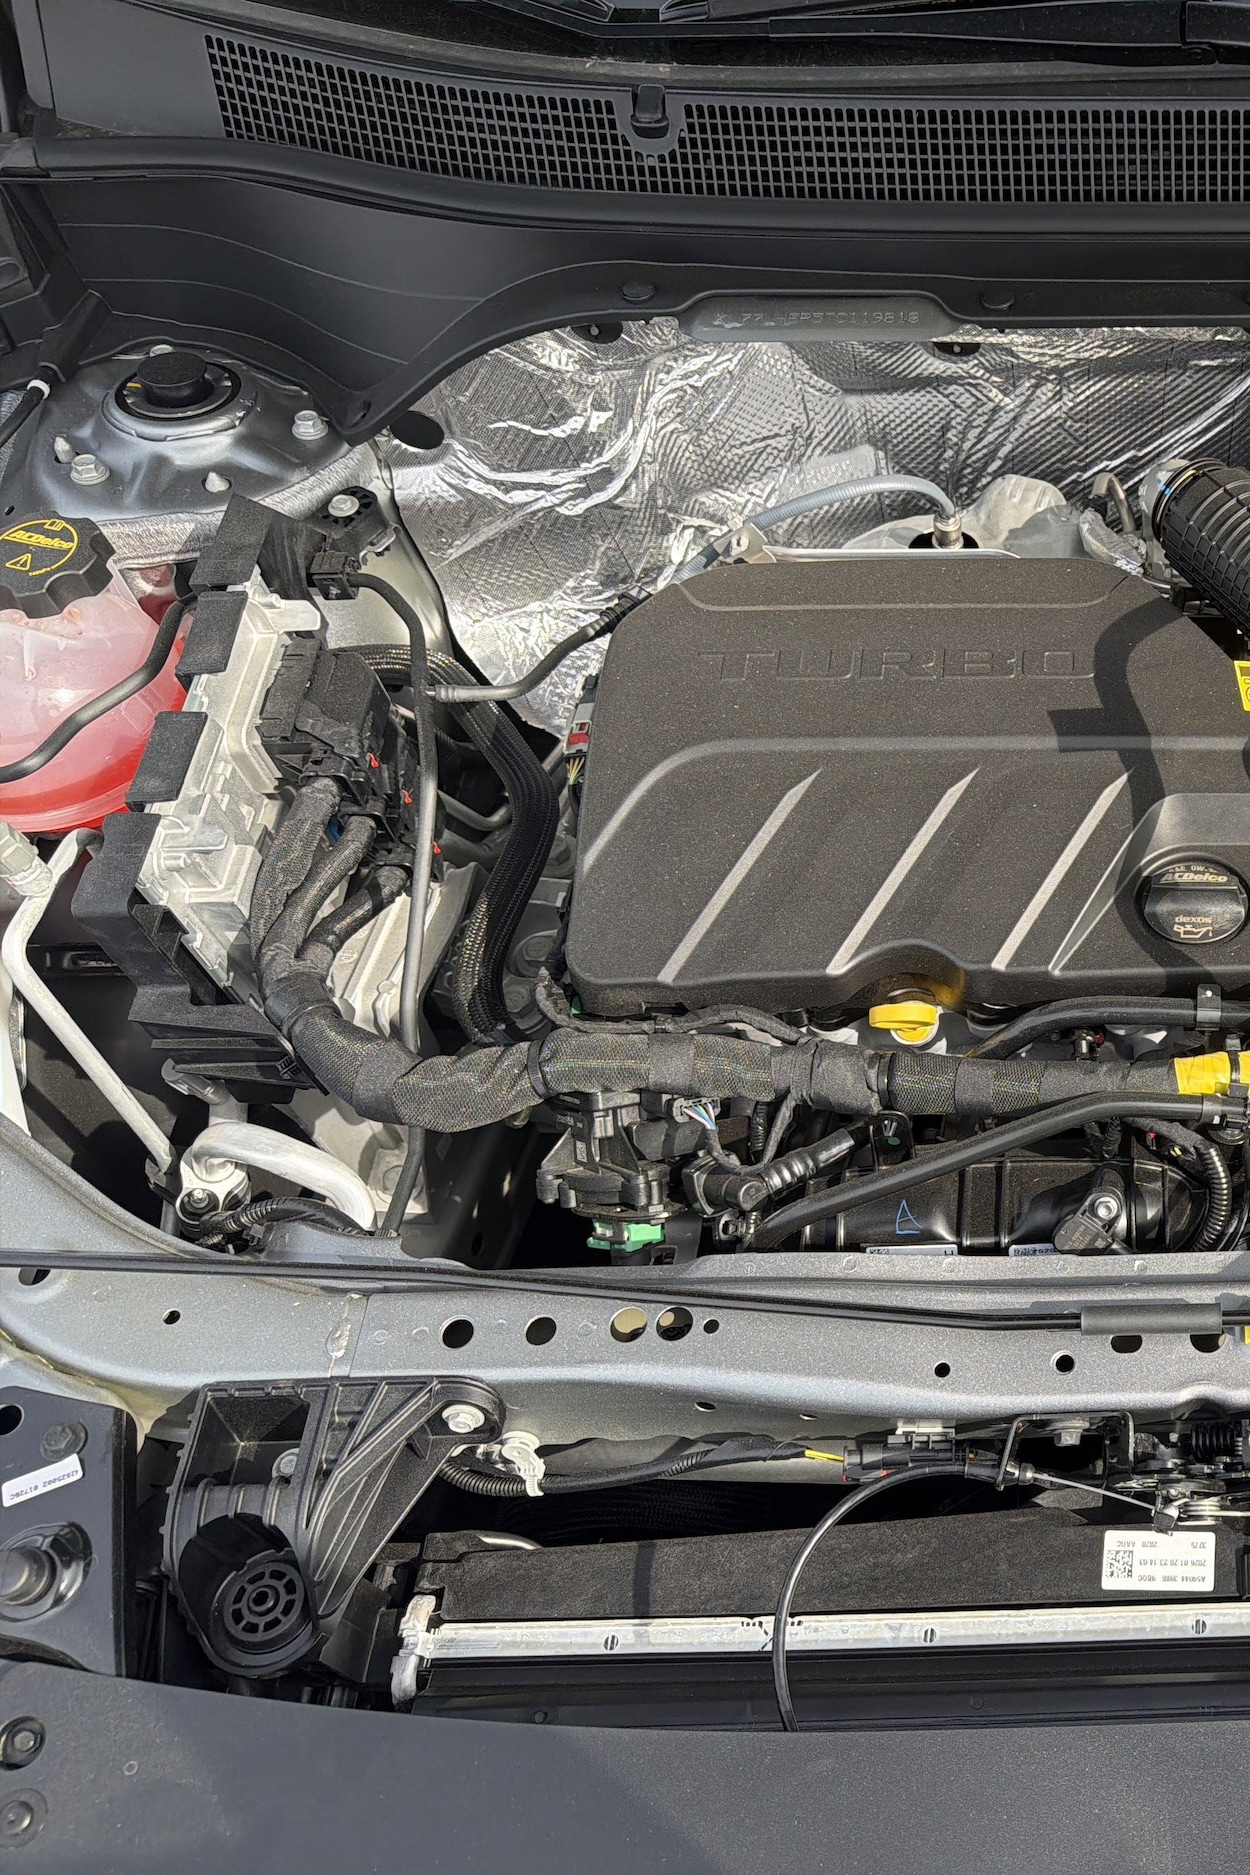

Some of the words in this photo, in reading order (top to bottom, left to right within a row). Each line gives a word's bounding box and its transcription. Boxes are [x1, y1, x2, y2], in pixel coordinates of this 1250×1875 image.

[9, 531, 74, 549] ACDelco
[697, 648, 1095, 682] TURBO
[1159, 872, 1229, 883] ACDelco
[1175, 915, 1213, 924] dexos
